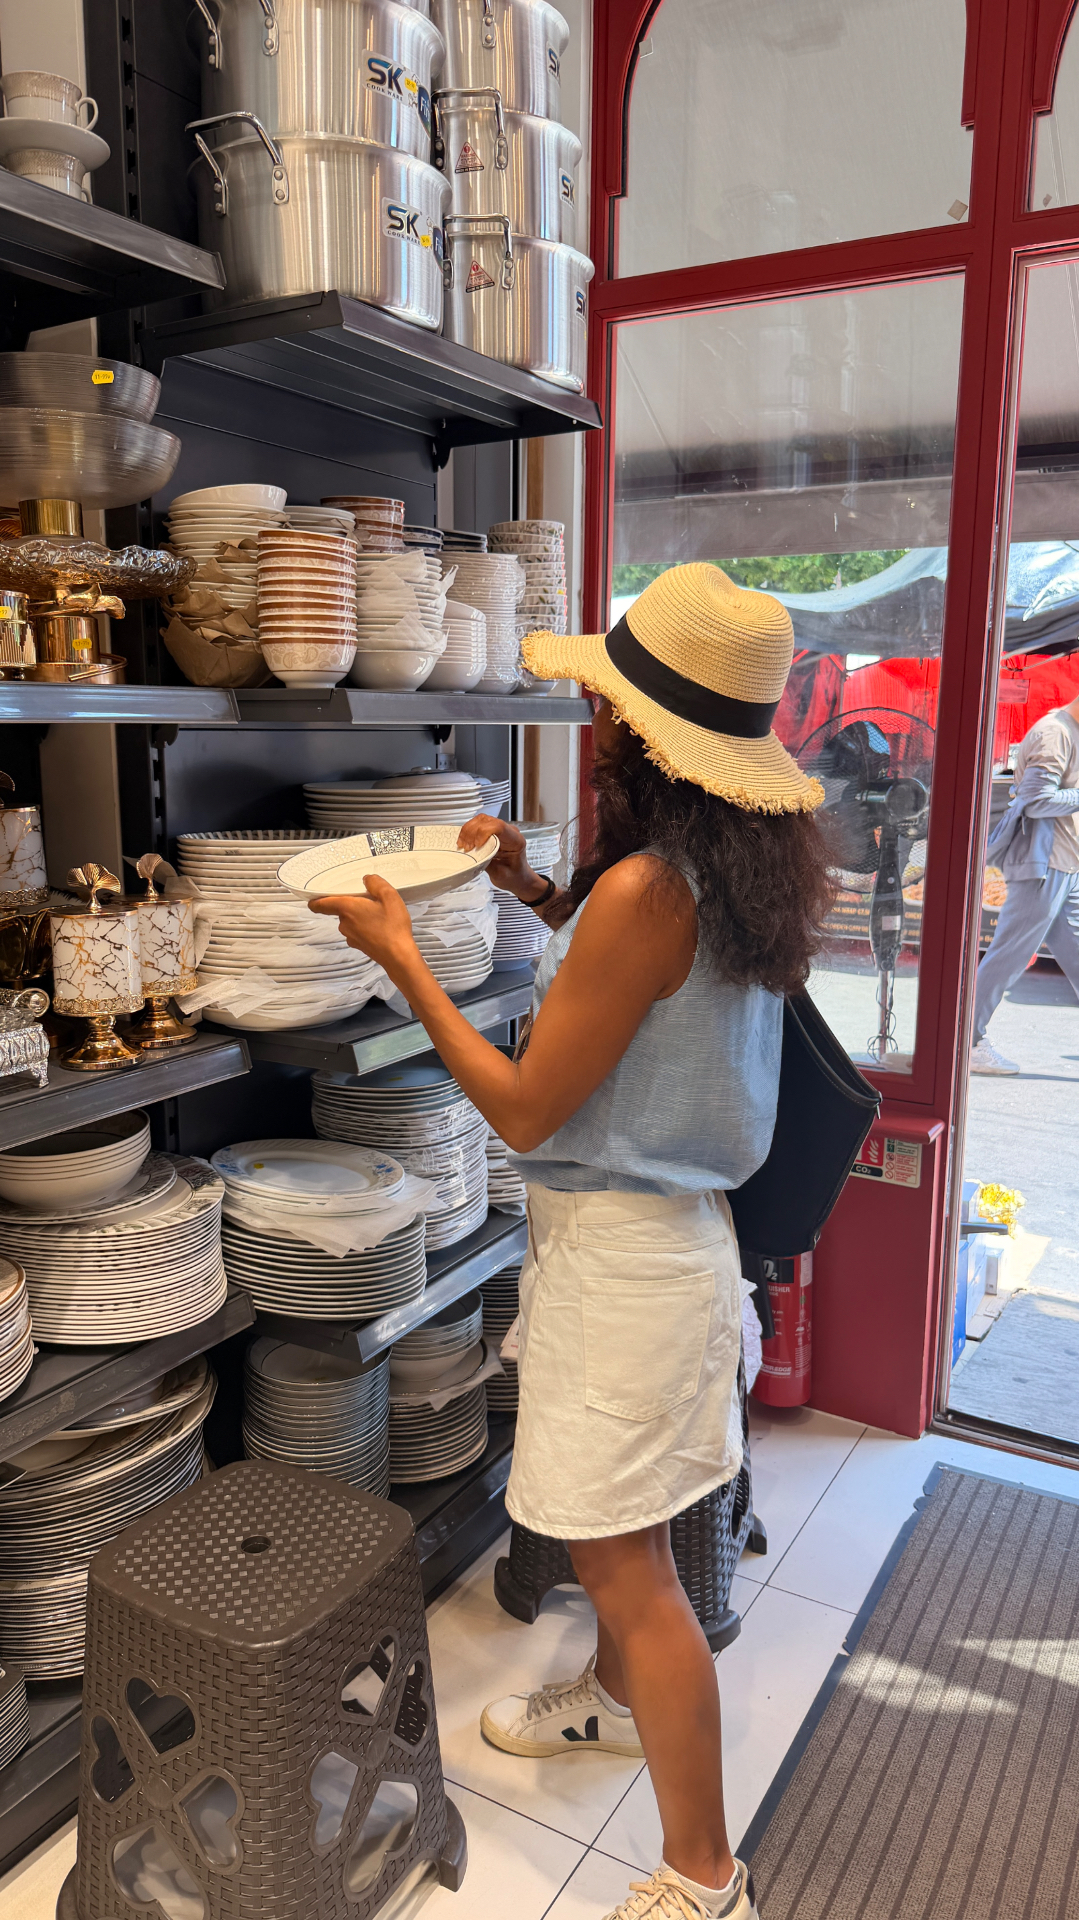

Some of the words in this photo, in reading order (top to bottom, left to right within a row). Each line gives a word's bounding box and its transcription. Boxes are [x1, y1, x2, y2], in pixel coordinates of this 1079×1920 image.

[366, 57, 404, 96] SK
[366, 82, 386, 94] COOK
[386, 204, 420, 239] SK
[387, 229, 405, 239] COOK
[768, 1284, 790, 1293] UISHER
